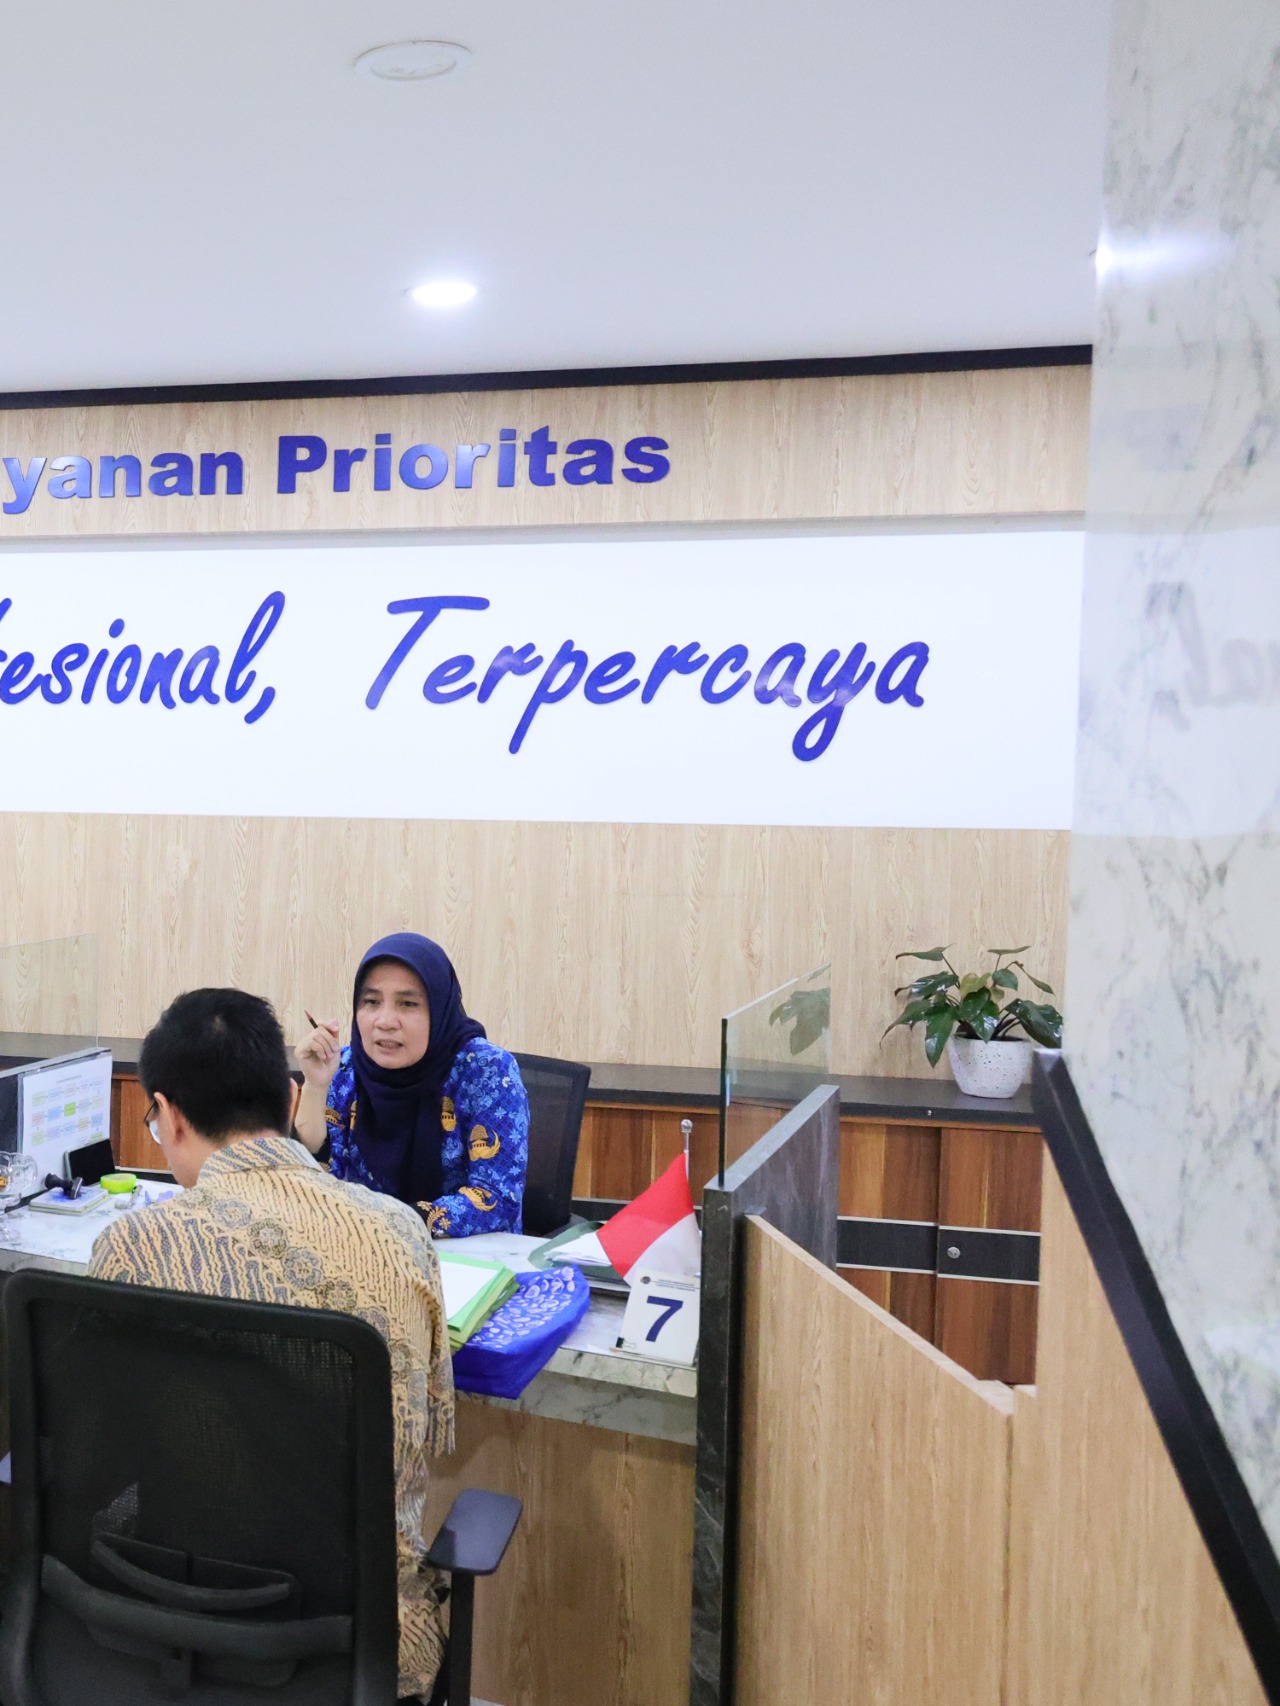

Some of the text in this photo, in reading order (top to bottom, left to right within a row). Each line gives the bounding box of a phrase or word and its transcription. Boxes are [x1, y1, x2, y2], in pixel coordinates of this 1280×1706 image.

[277, 425, 671, 494] Prioritas
[365, 595, 930, 762] Terpercaya
[645, 1295, 684, 1343] 7
